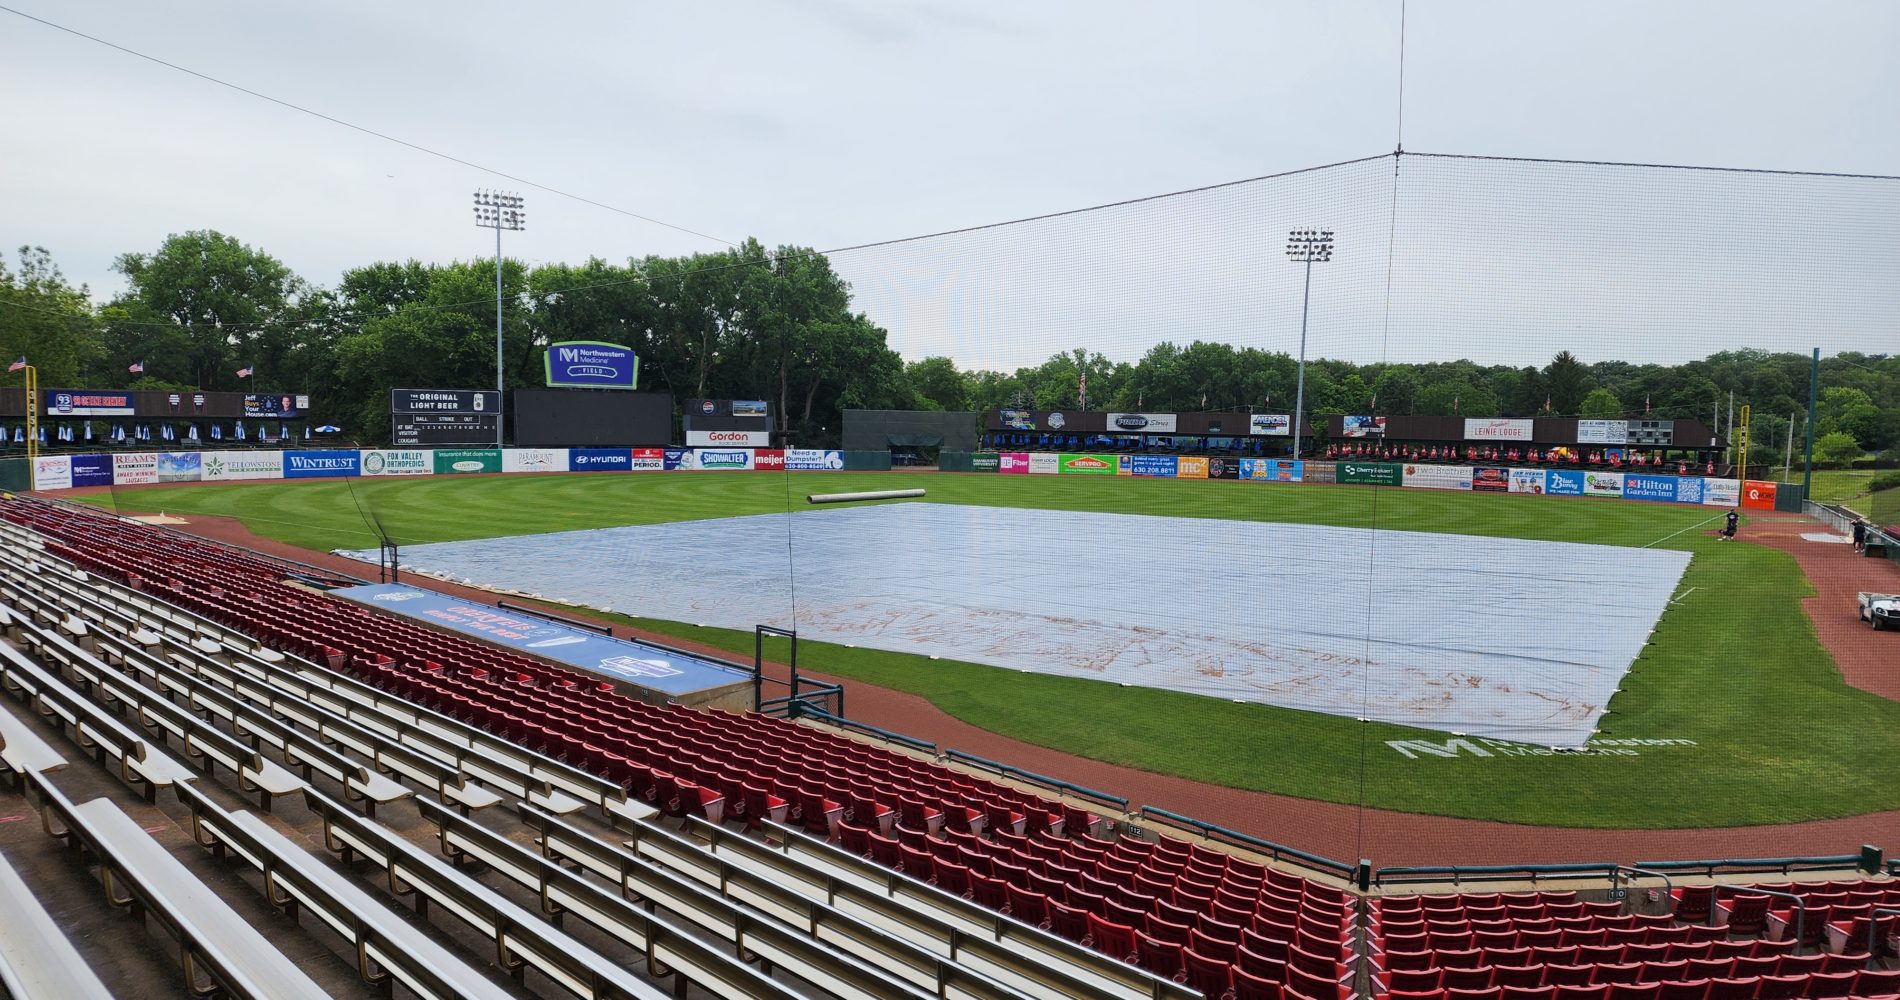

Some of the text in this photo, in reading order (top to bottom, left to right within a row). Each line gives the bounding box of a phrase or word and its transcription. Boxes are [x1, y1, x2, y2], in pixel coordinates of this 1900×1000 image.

[580, 349, 625, 358] Northwestern
[710, 432, 748, 440] Gordon
[1500, 428, 1521, 436] LODGE
[115, 454, 157, 464] REAM'S
[290, 457, 355, 468] WINTRUST
[704, 454, 745, 463] SHOWALTER
[756, 455, 784, 466] meijer
[1436, 466, 1472, 476] Brothers
[1638, 480, 1672, 490] Hilton
[1130, 826, 1141, 834] 112
